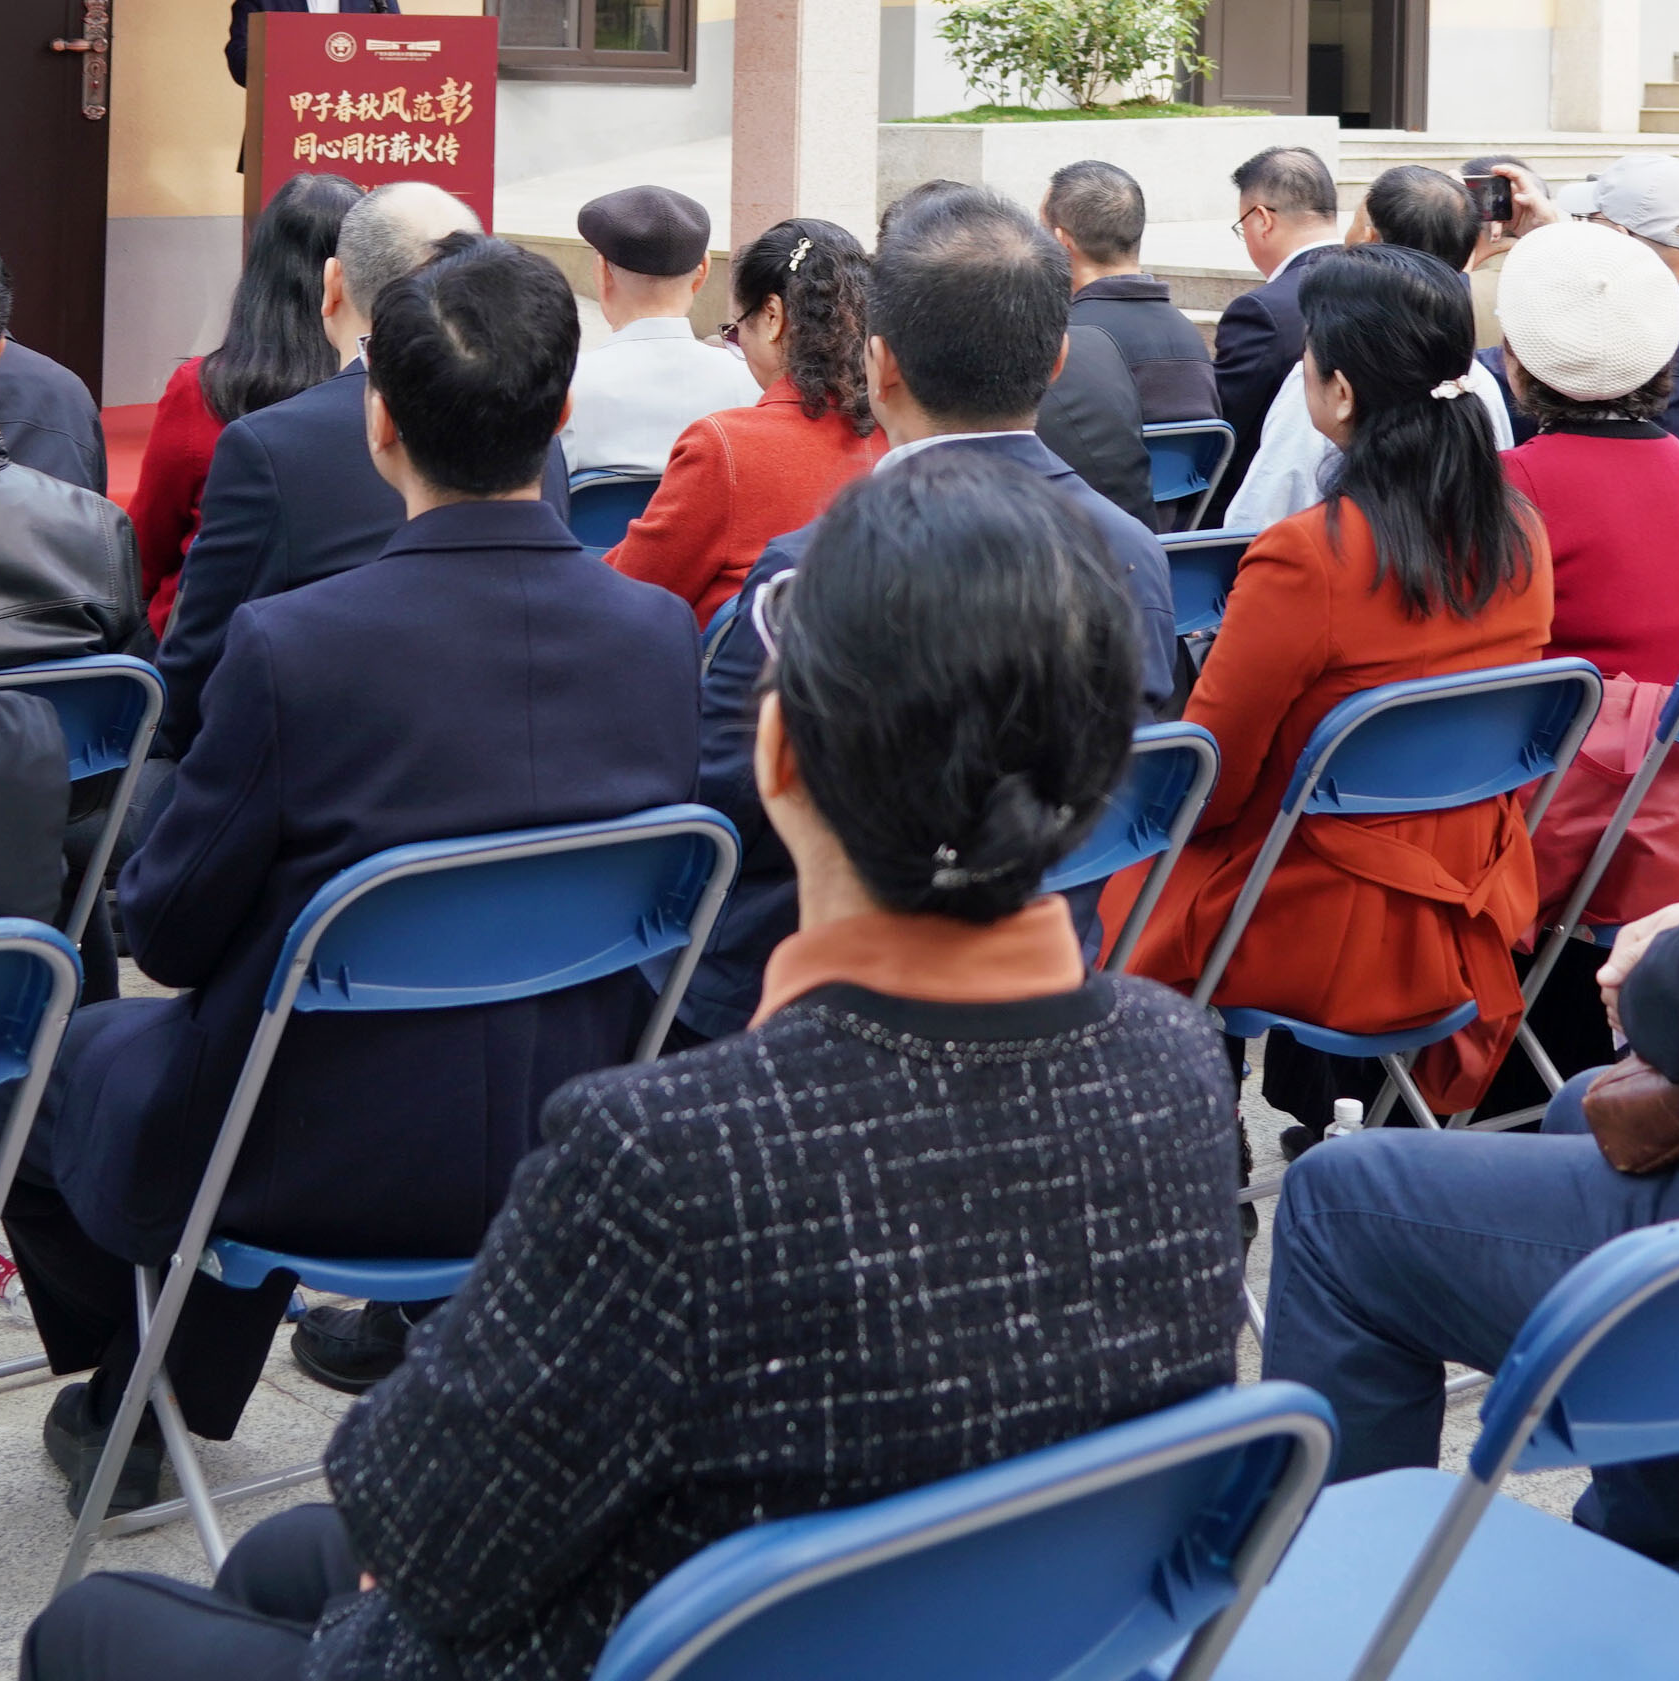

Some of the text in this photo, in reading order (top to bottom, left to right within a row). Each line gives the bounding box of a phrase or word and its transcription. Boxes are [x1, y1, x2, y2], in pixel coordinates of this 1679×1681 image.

[289, 76, 474, 126] 甲子春秋风范彰
[293, 131, 461, 166] 同心同行薪火传
